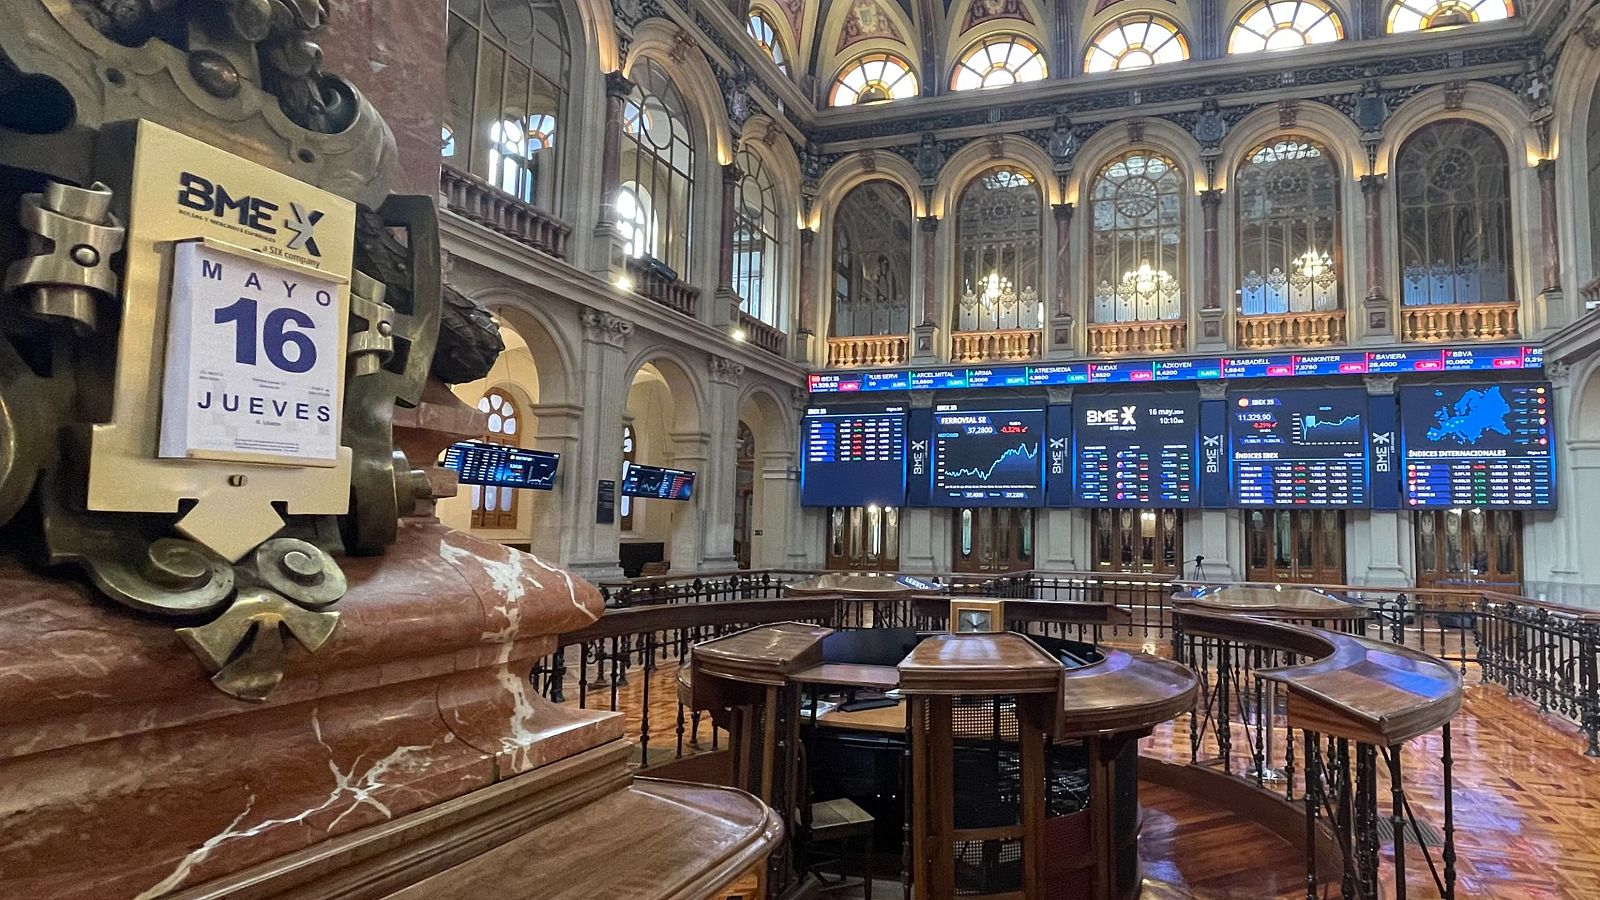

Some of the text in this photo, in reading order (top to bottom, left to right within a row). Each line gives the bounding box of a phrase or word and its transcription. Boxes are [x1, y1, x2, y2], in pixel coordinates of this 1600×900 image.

[178, 172, 278, 235] BME
[269, 246, 284, 257] SIX
[284, 252, 321, 269] company
[201, 259, 331, 307] MAYO
[214, 297, 317, 374] 16
[1034, 366, 1072, 374] ATRESMEDIA
[197, 391, 331, 423] JUEVES
[1087, 410, 1119, 423] BME
[1149, 408, 1158, 416] 16
[967, 427, 993, 435] 37,2800
[913, 452, 922, 475] BME
[1052, 451, 1061, 474] BME
[1206, 449, 1217, 473] BME
[1376, 446, 1388, 472] BME
